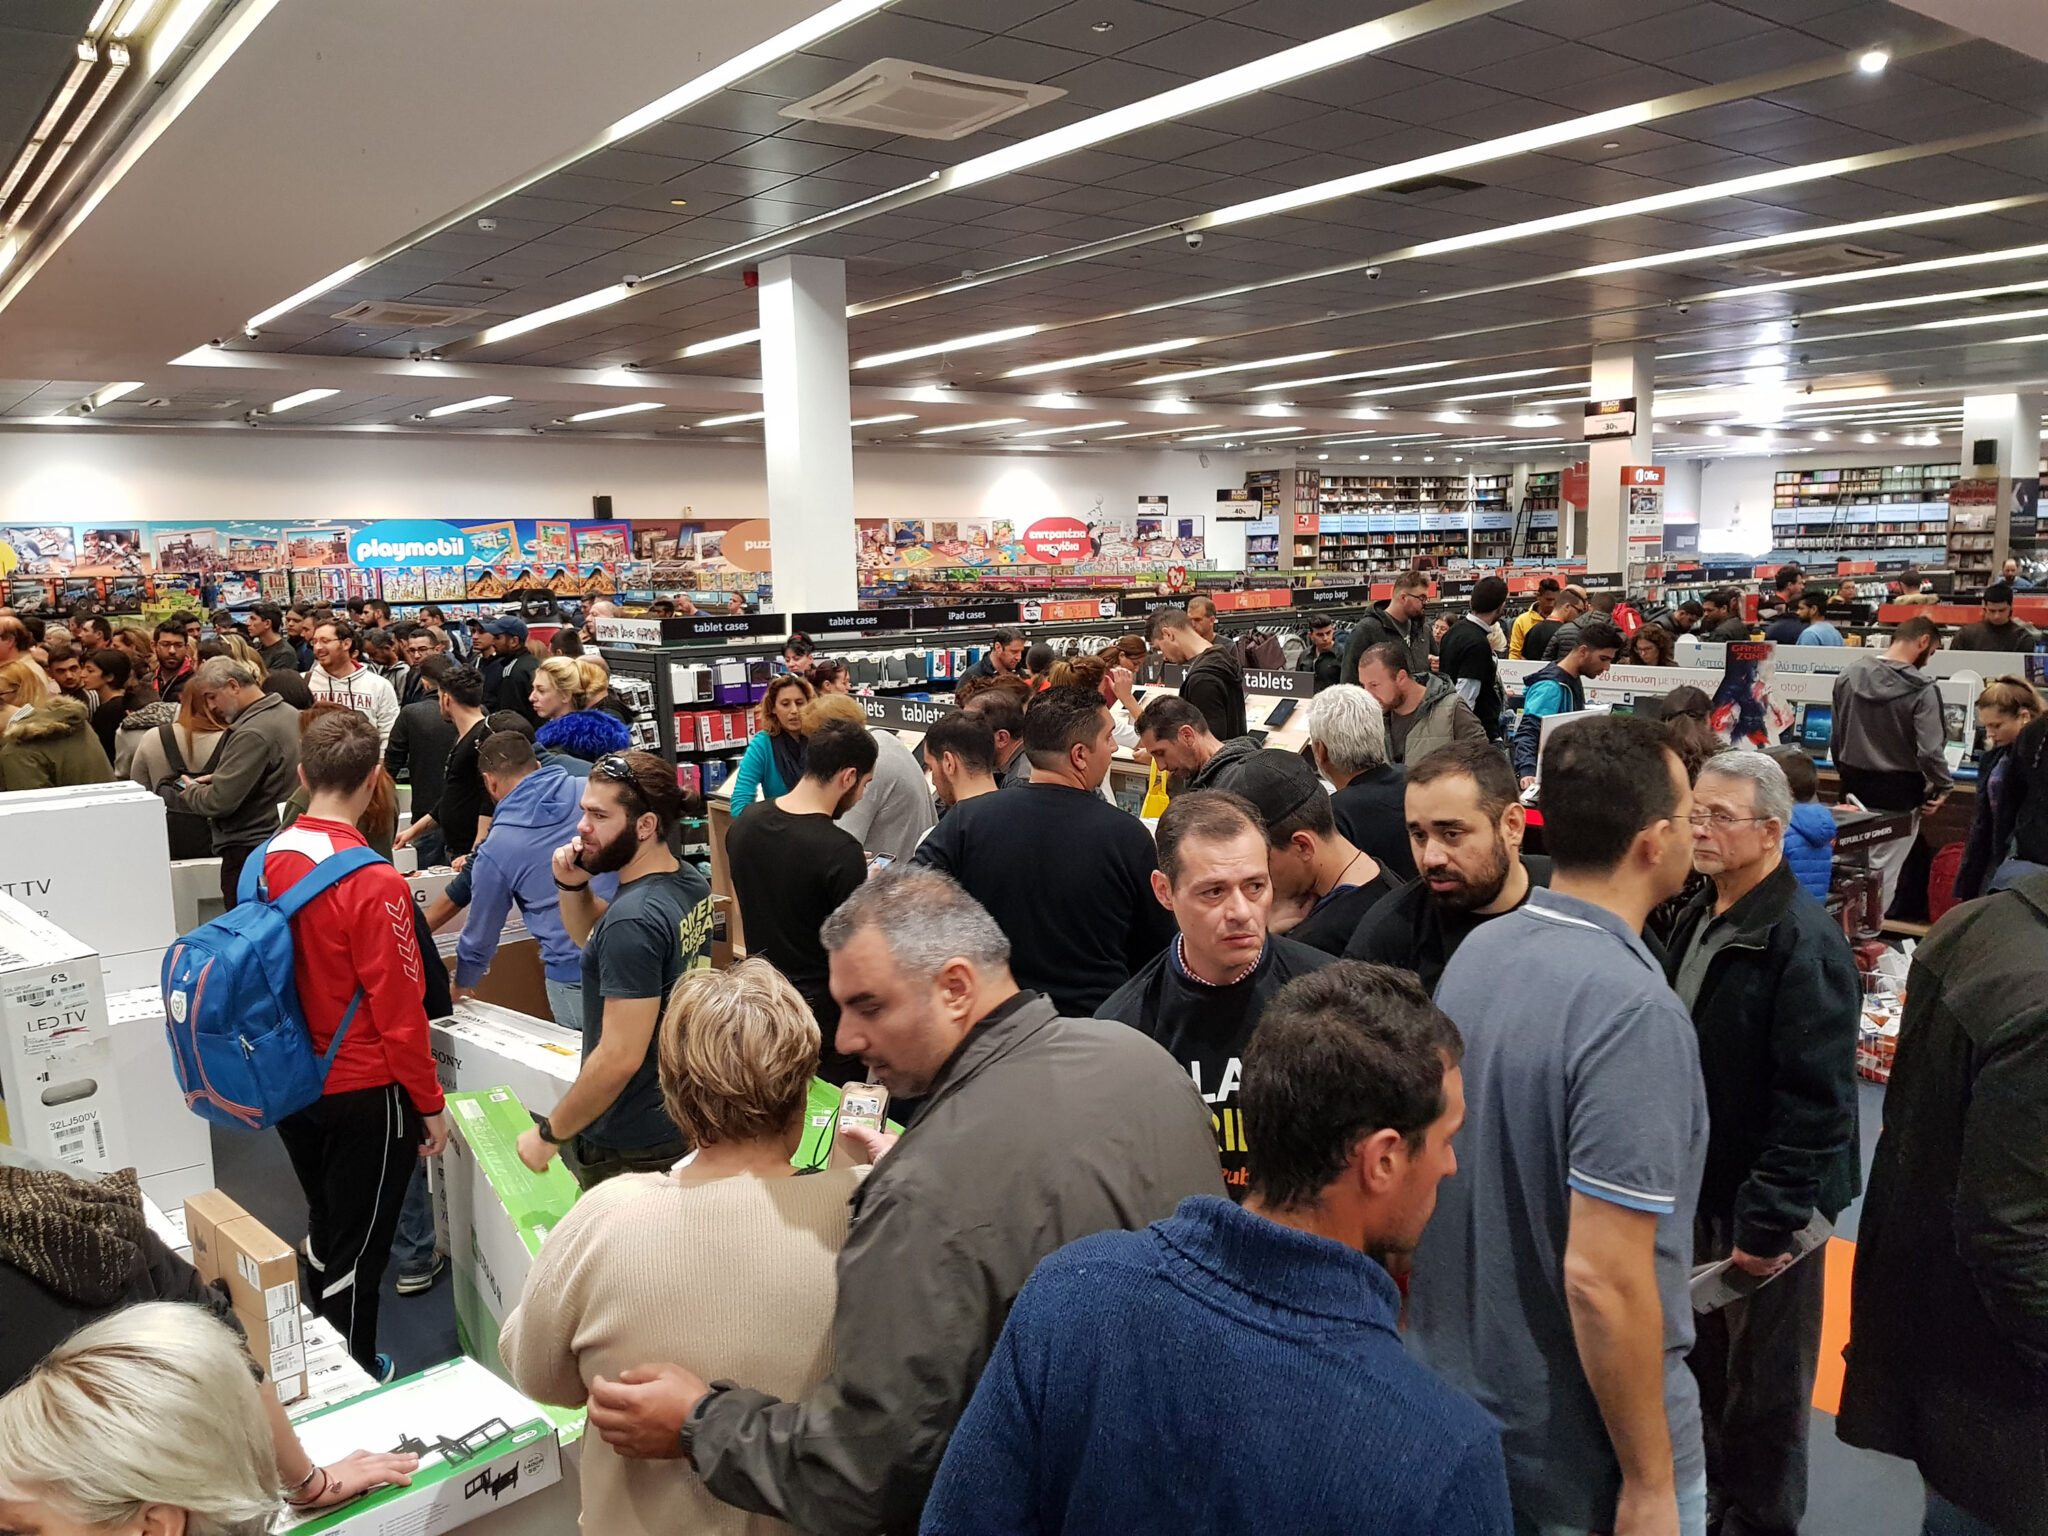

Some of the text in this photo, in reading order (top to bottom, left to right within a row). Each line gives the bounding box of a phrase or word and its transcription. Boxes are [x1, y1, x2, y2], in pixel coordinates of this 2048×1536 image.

[357, 537, 464, 562] playmobil
[744, 540, 772, 551] puzz
[1313, 589, 1349, 601] laptop bags
[1459, 583, 1475, 593] lapto
[829, 616, 878, 627] tablet cases
[948, 611, 986, 621] iPad cases
[694, 620, 749, 633] tablet cases
[1736, 652, 1767, 660] ZONE
[1499, 667, 1518, 677] Office
[1611, 672, 1656, 686] έκπτωση
[1244, 671, 1294, 691] tablets
[313, 692, 372, 708] ANHATTAN
[21, 878, 51, 897] TV
[27, 1009, 86, 1033] LED TV
[431, 1048, 462, 1070] SONY
[1190, 1057, 1242, 1104] LA
[49, 1111, 97, 1131] 32LJ500V
